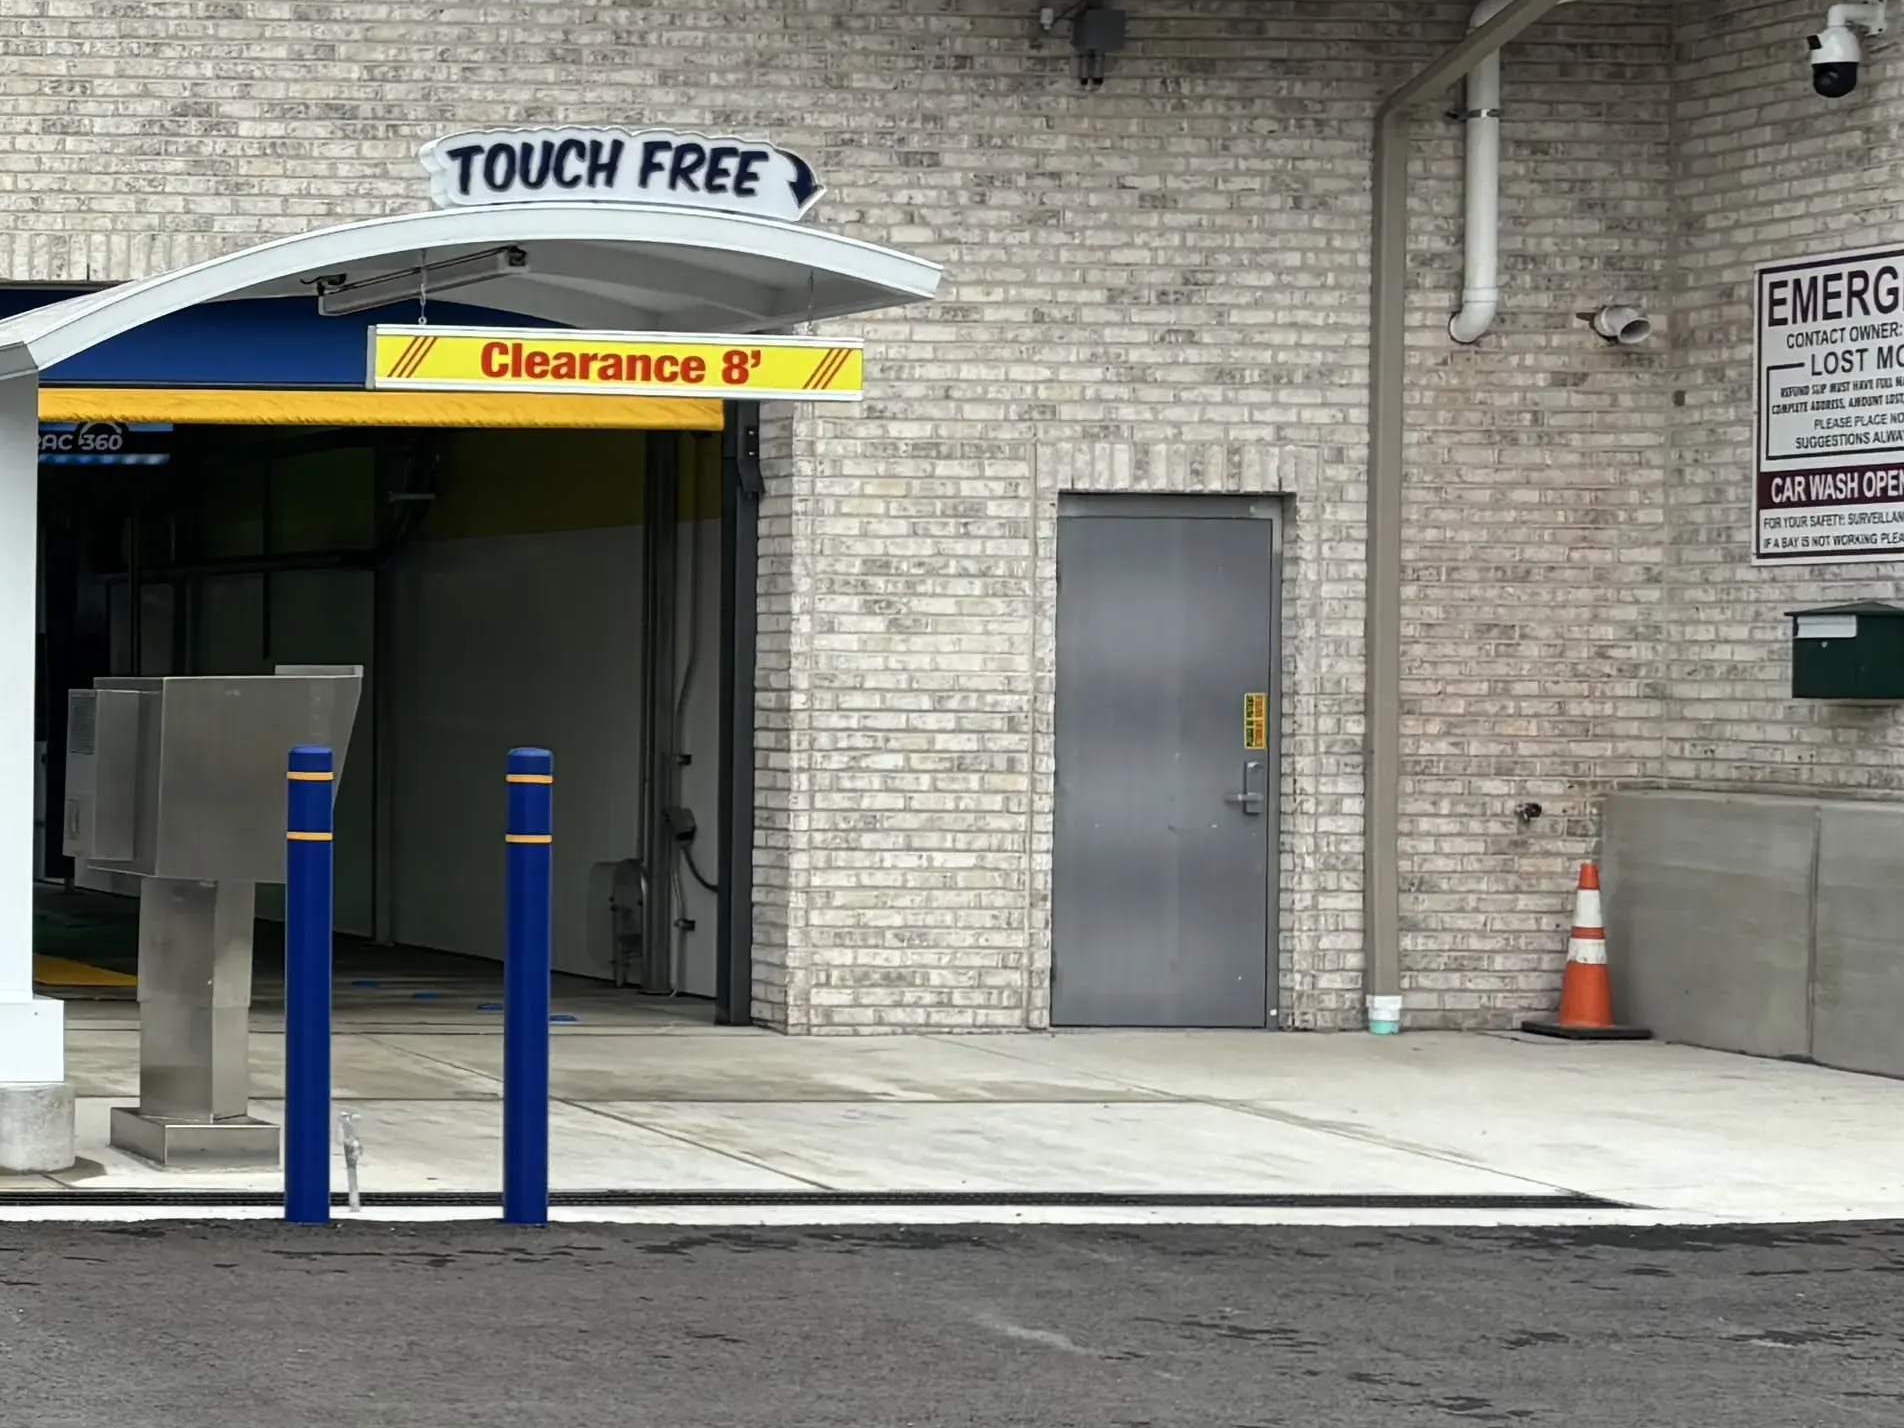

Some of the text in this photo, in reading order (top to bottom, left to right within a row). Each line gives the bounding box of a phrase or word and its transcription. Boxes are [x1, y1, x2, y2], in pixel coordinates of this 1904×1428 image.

[447, 138, 771, 197] TOUCH FREE
[1768, 266, 1904, 327] EMERG
[1786, 322, 1903, 349] CONTACT OWNER:
[481, 342, 762, 385] Clearance 8'
[1811, 348, 1868, 376] LOST
[1853, 379, 1873, 391] HAVE
[1814, 416, 1852, 430] PLEASE
[1854, 413, 1887, 426] PLACE
[81, 433, 123, 451] 360
[1795, 429, 1904, 449] SUGGESTIONS ALWA
[1771, 476, 1806, 503] CAR
[1809, 472, 1858, 500] WASH
[1764, 516, 1781, 529] FOR
[1783, 515, 1808, 528] YOUR
[1764, 537, 1771, 549] IF
[1773, 537, 1780, 549] A
[1781, 536, 1800, 548] BAY
[1801, 535, 1809, 547] IS
[1812, 535, 1830, 547] NOT
[1832, 533, 1877, 546] WORKING
